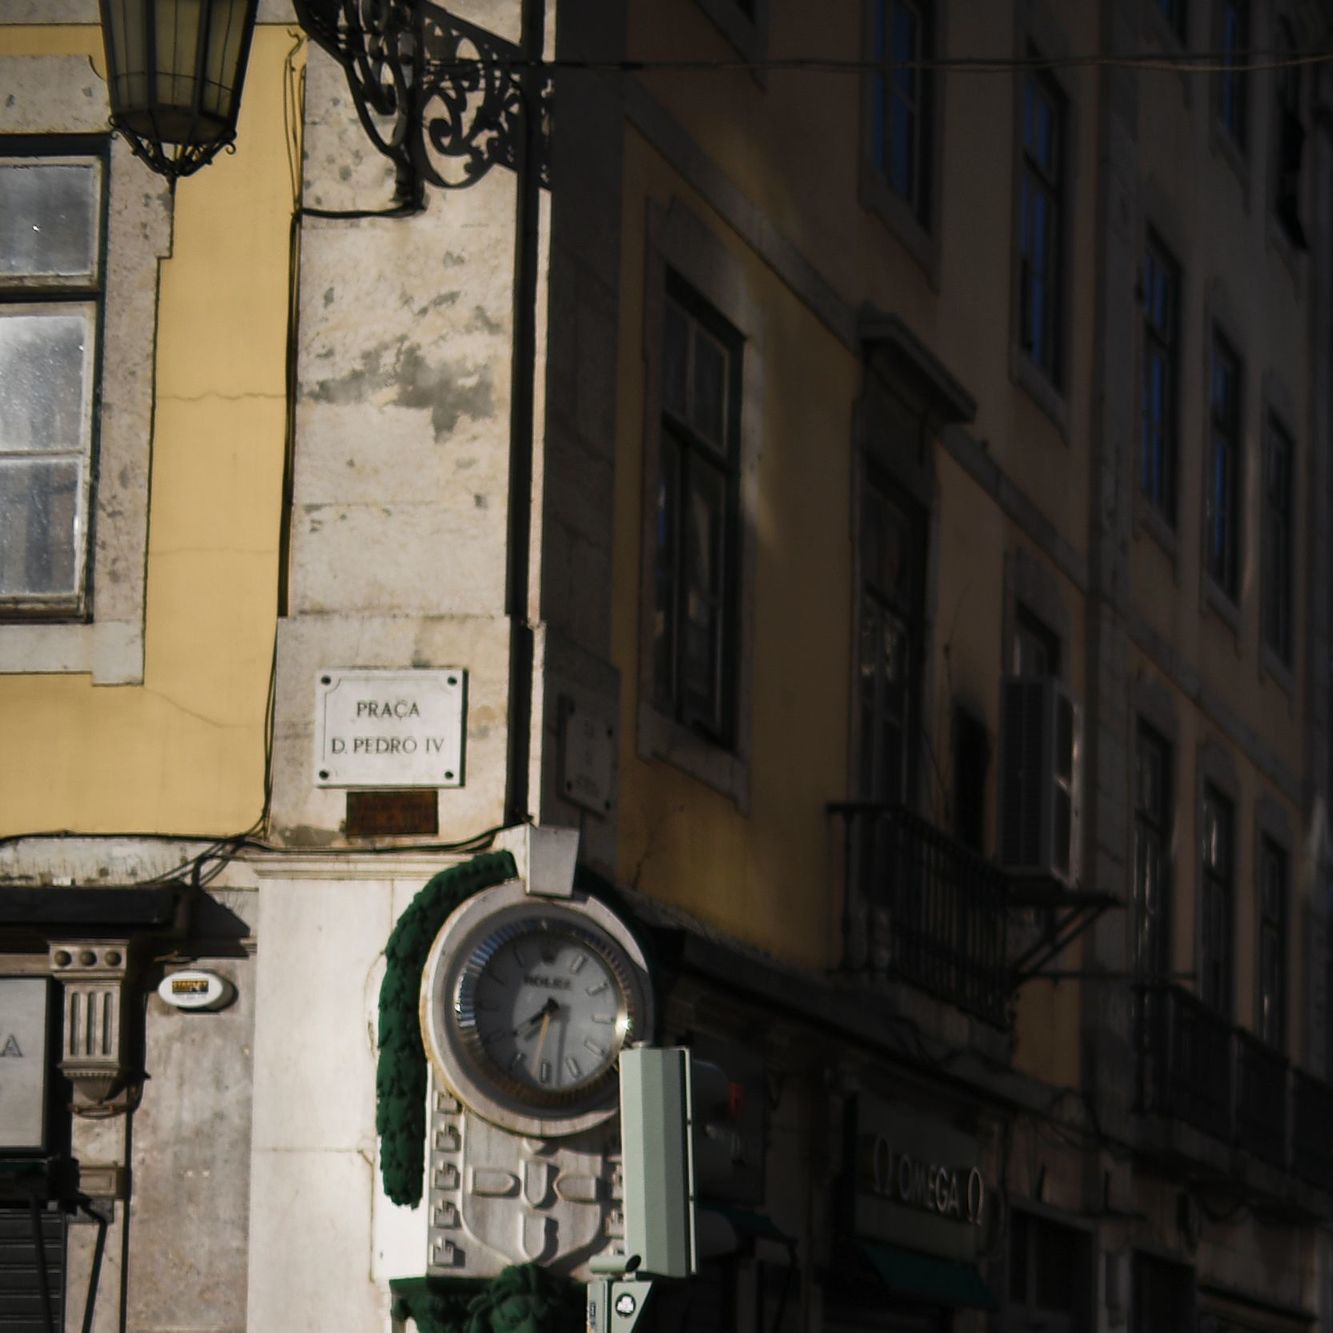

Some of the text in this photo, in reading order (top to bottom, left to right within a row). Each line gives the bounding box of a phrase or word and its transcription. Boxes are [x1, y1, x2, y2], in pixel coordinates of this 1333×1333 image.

[356, 702, 420, 720] PRAÇA
[331, 737, 445, 755] D. PEDRO IV
[899, 1153, 961, 1218] OMEGA
